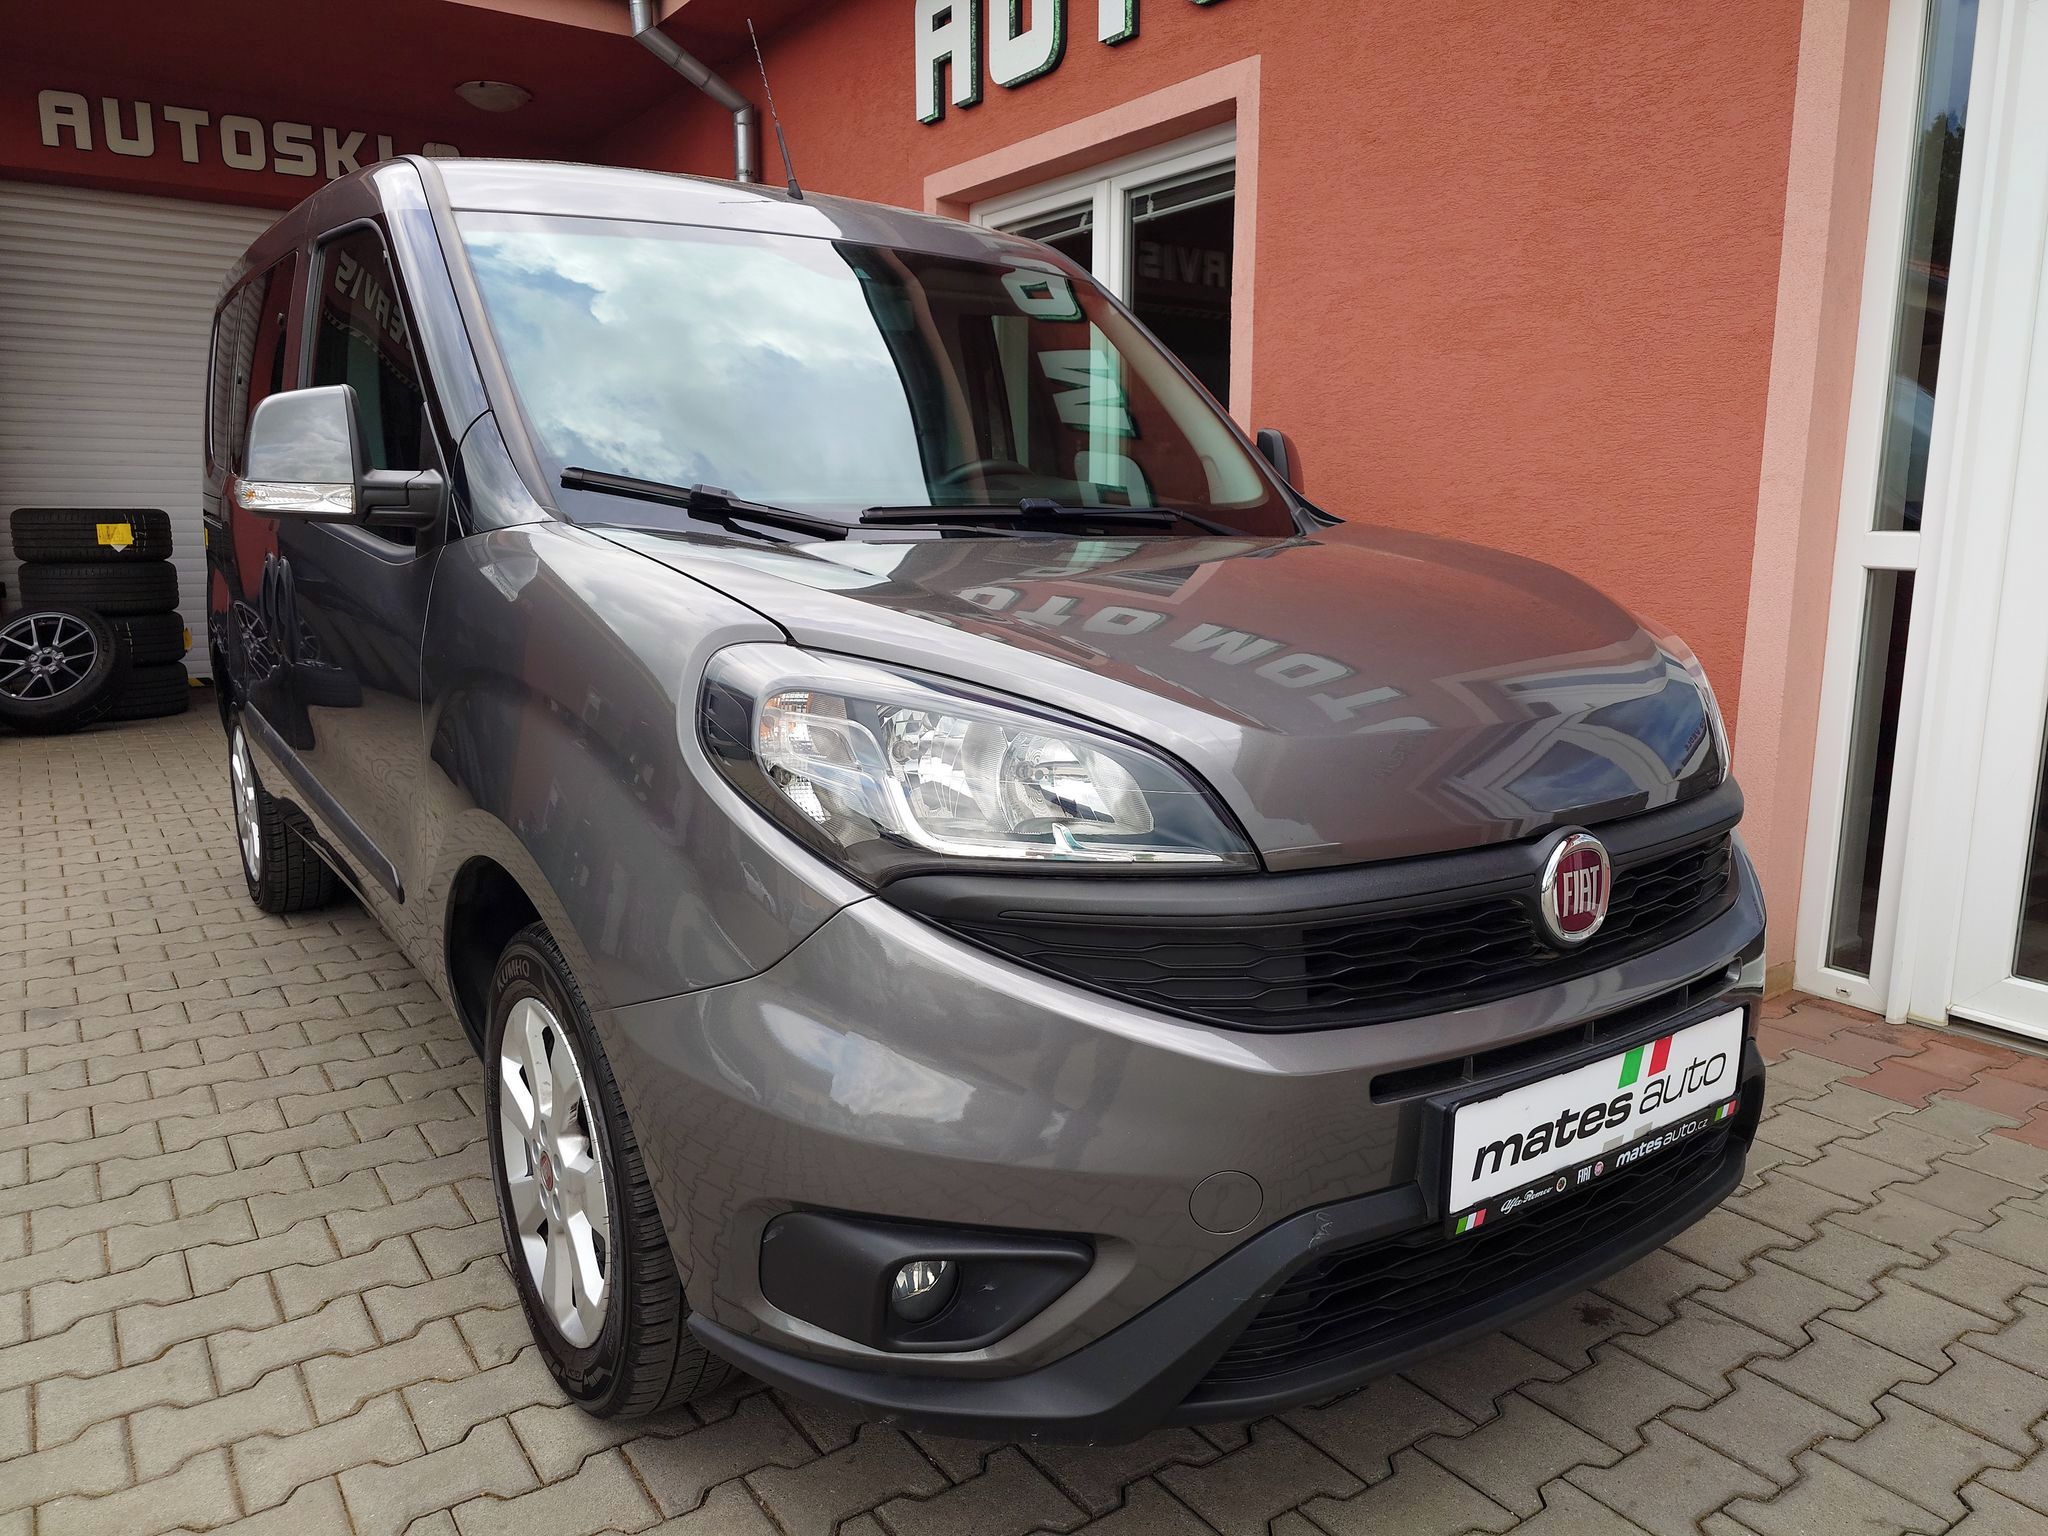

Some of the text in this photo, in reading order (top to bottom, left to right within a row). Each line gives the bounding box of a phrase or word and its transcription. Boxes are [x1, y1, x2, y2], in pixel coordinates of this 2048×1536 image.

[1563, 865, 1600, 918] FIAT
[497, 959, 530, 993] KUMHO
[1471, 1052, 1727, 1182] mates auto
[1577, 1165, 1592, 1185] FIAT
